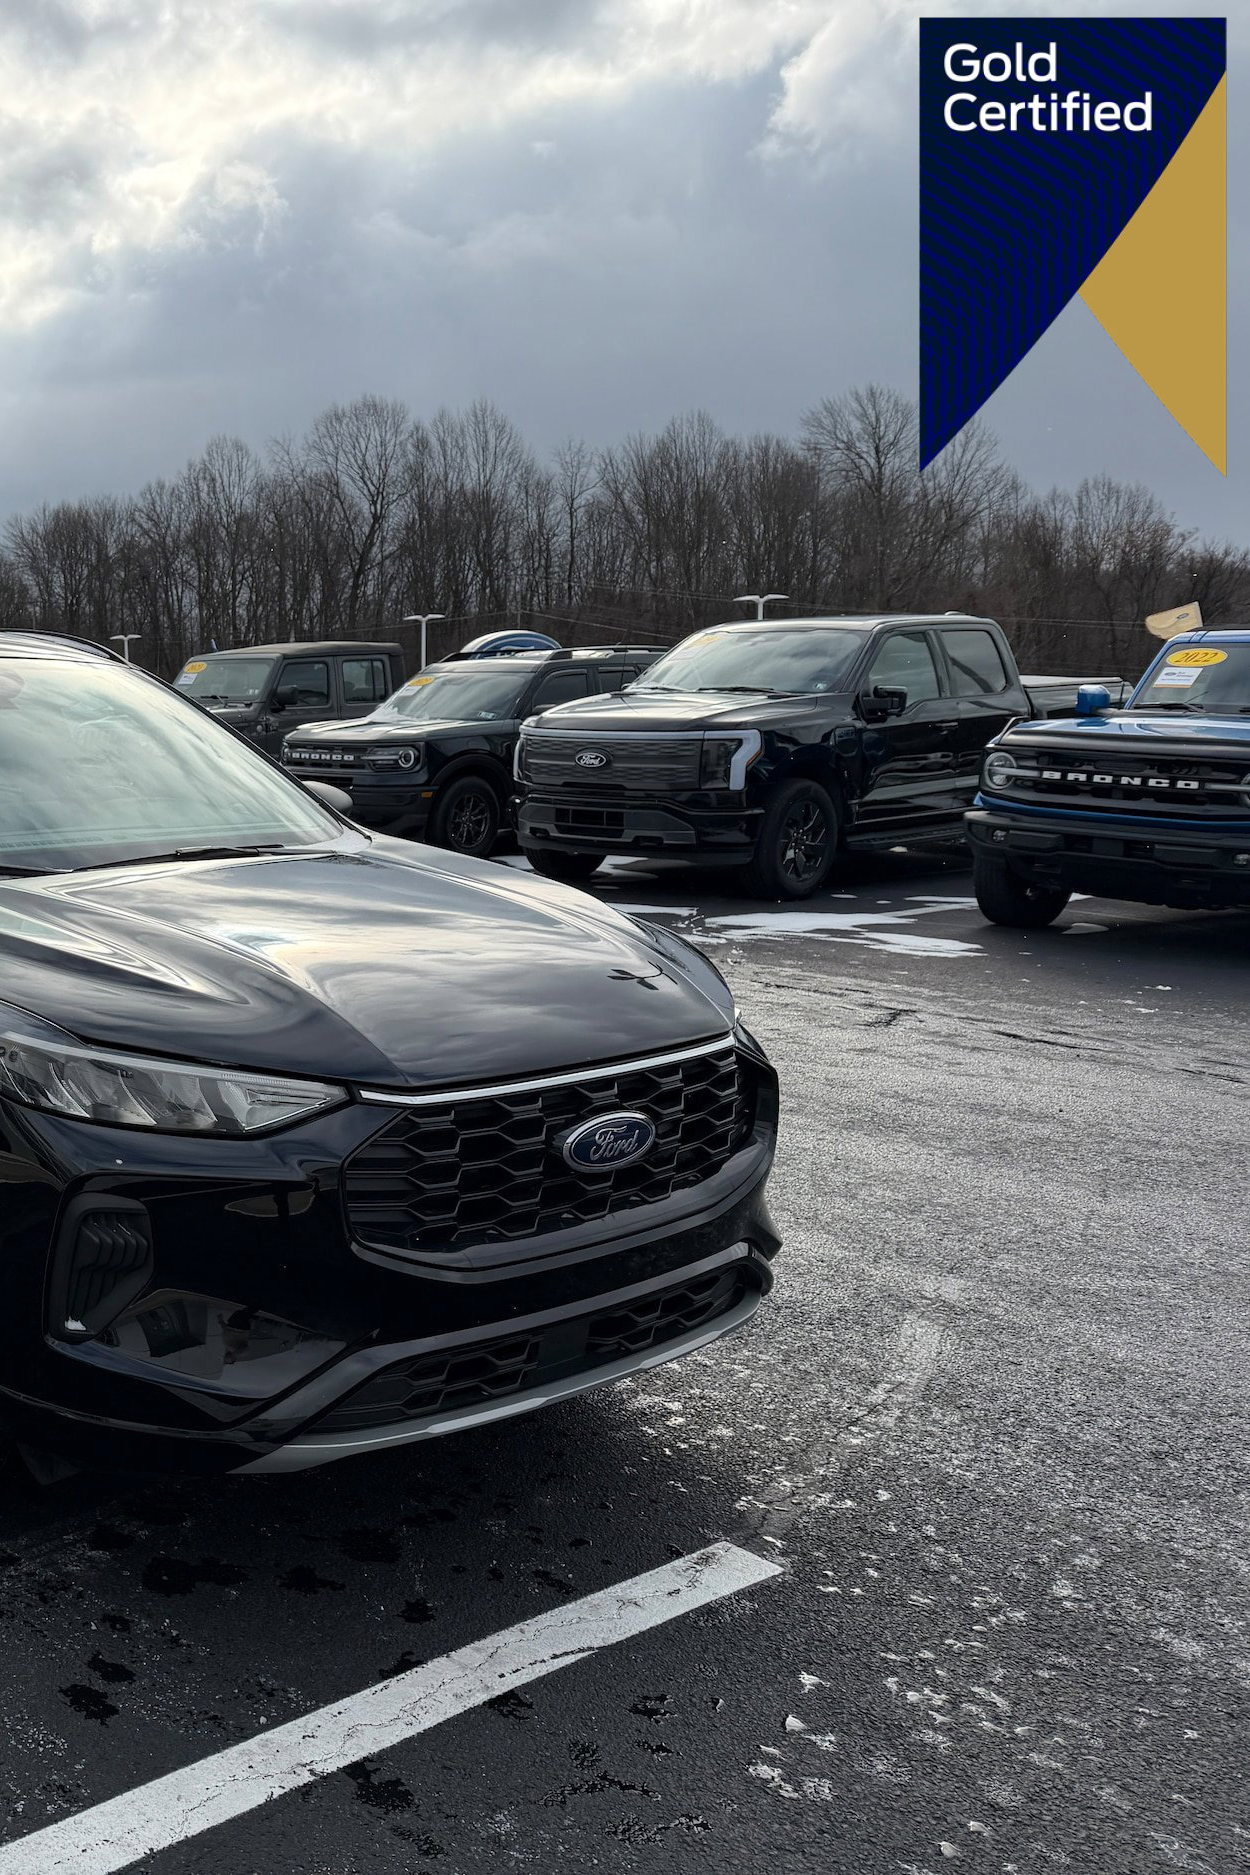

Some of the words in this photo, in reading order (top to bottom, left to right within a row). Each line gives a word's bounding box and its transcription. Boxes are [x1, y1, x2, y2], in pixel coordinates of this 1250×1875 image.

[1174, 652, 1219, 663] 2022
[291, 752, 355, 761] BRONCO
[580, 754, 601, 765] Ford
[1041, 769, 1200, 791] BRONCO
[588, 1124, 641, 1162] Ford
